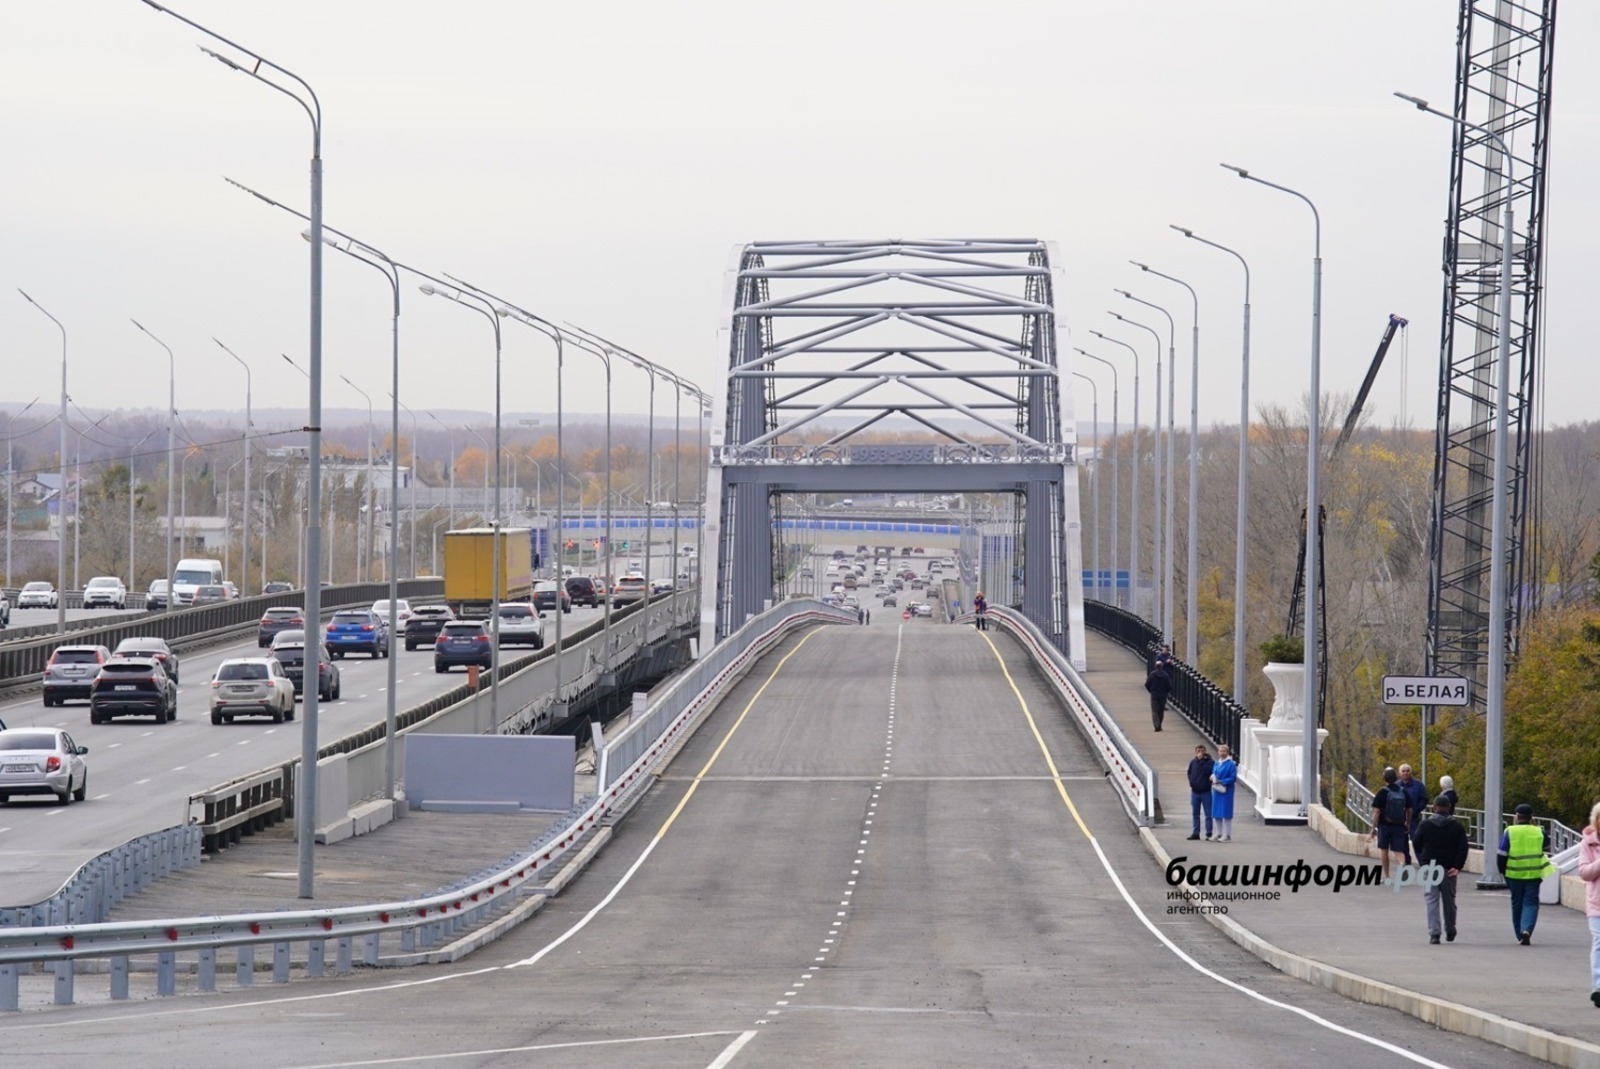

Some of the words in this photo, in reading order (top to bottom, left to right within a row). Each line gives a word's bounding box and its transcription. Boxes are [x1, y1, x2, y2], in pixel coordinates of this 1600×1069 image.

[852, 447, 934, 462] 1953-1956
[1386, 687, 1400, 700] р.
[1404, 684, 1465, 699] БЕЛАЯ
